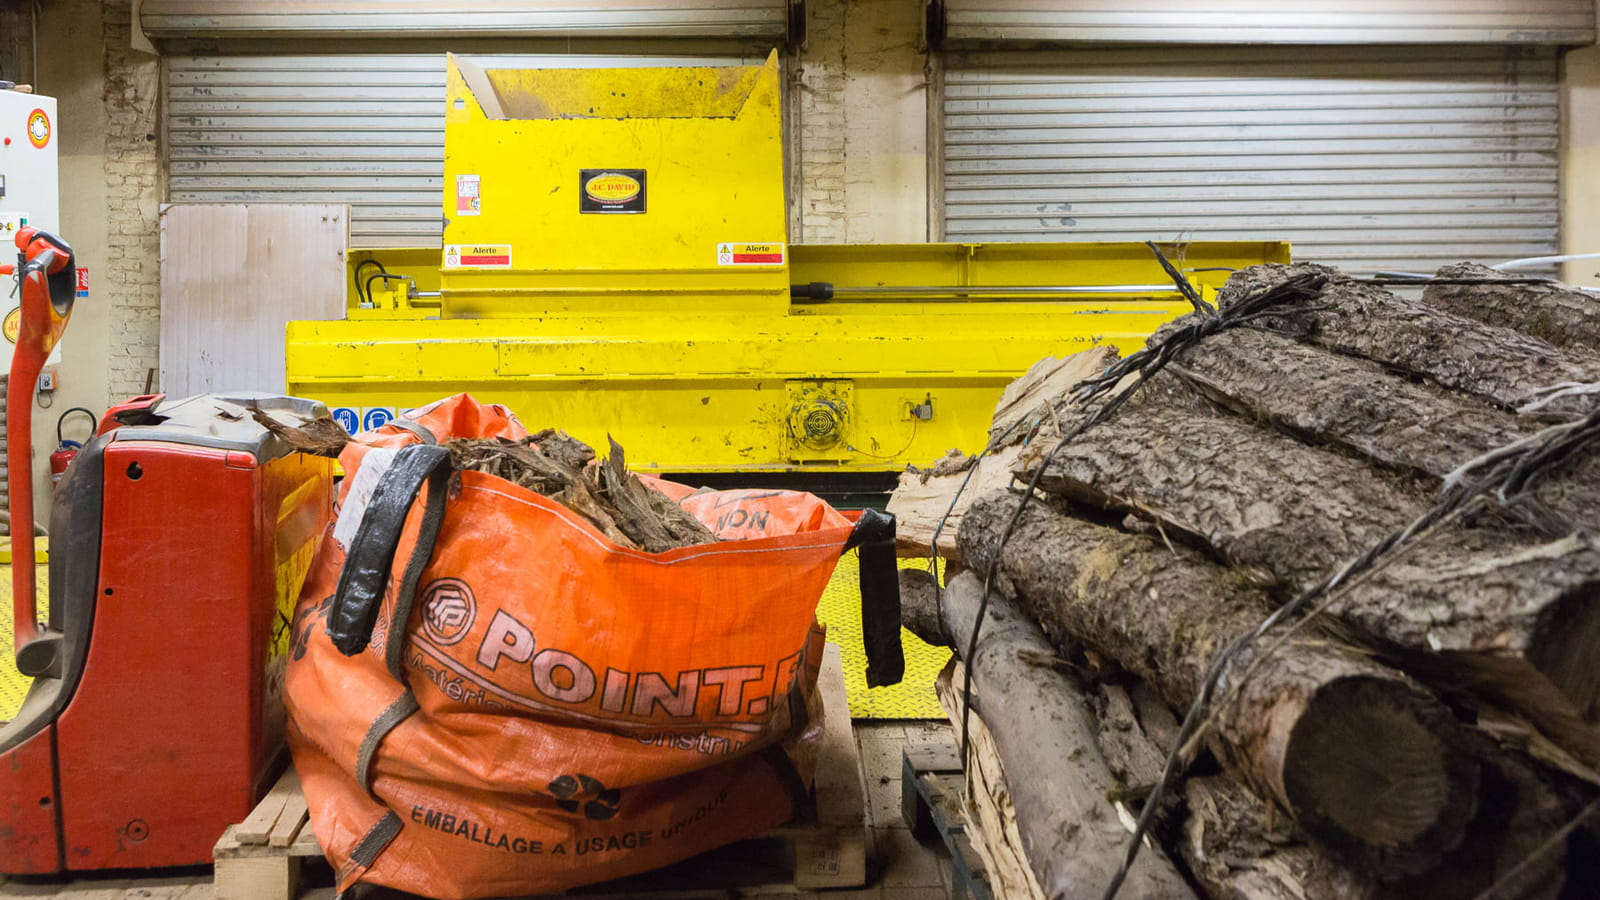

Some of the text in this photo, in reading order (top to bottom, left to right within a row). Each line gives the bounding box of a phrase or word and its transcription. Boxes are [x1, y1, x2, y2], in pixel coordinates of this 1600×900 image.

[607, 183, 636, 191] DAVID
[472, 247, 497, 255] Alerte
[745, 245, 770, 253] Alerte
[410, 804, 544, 855] EMBALLAGE
[575, 831, 653, 856] USAGE
